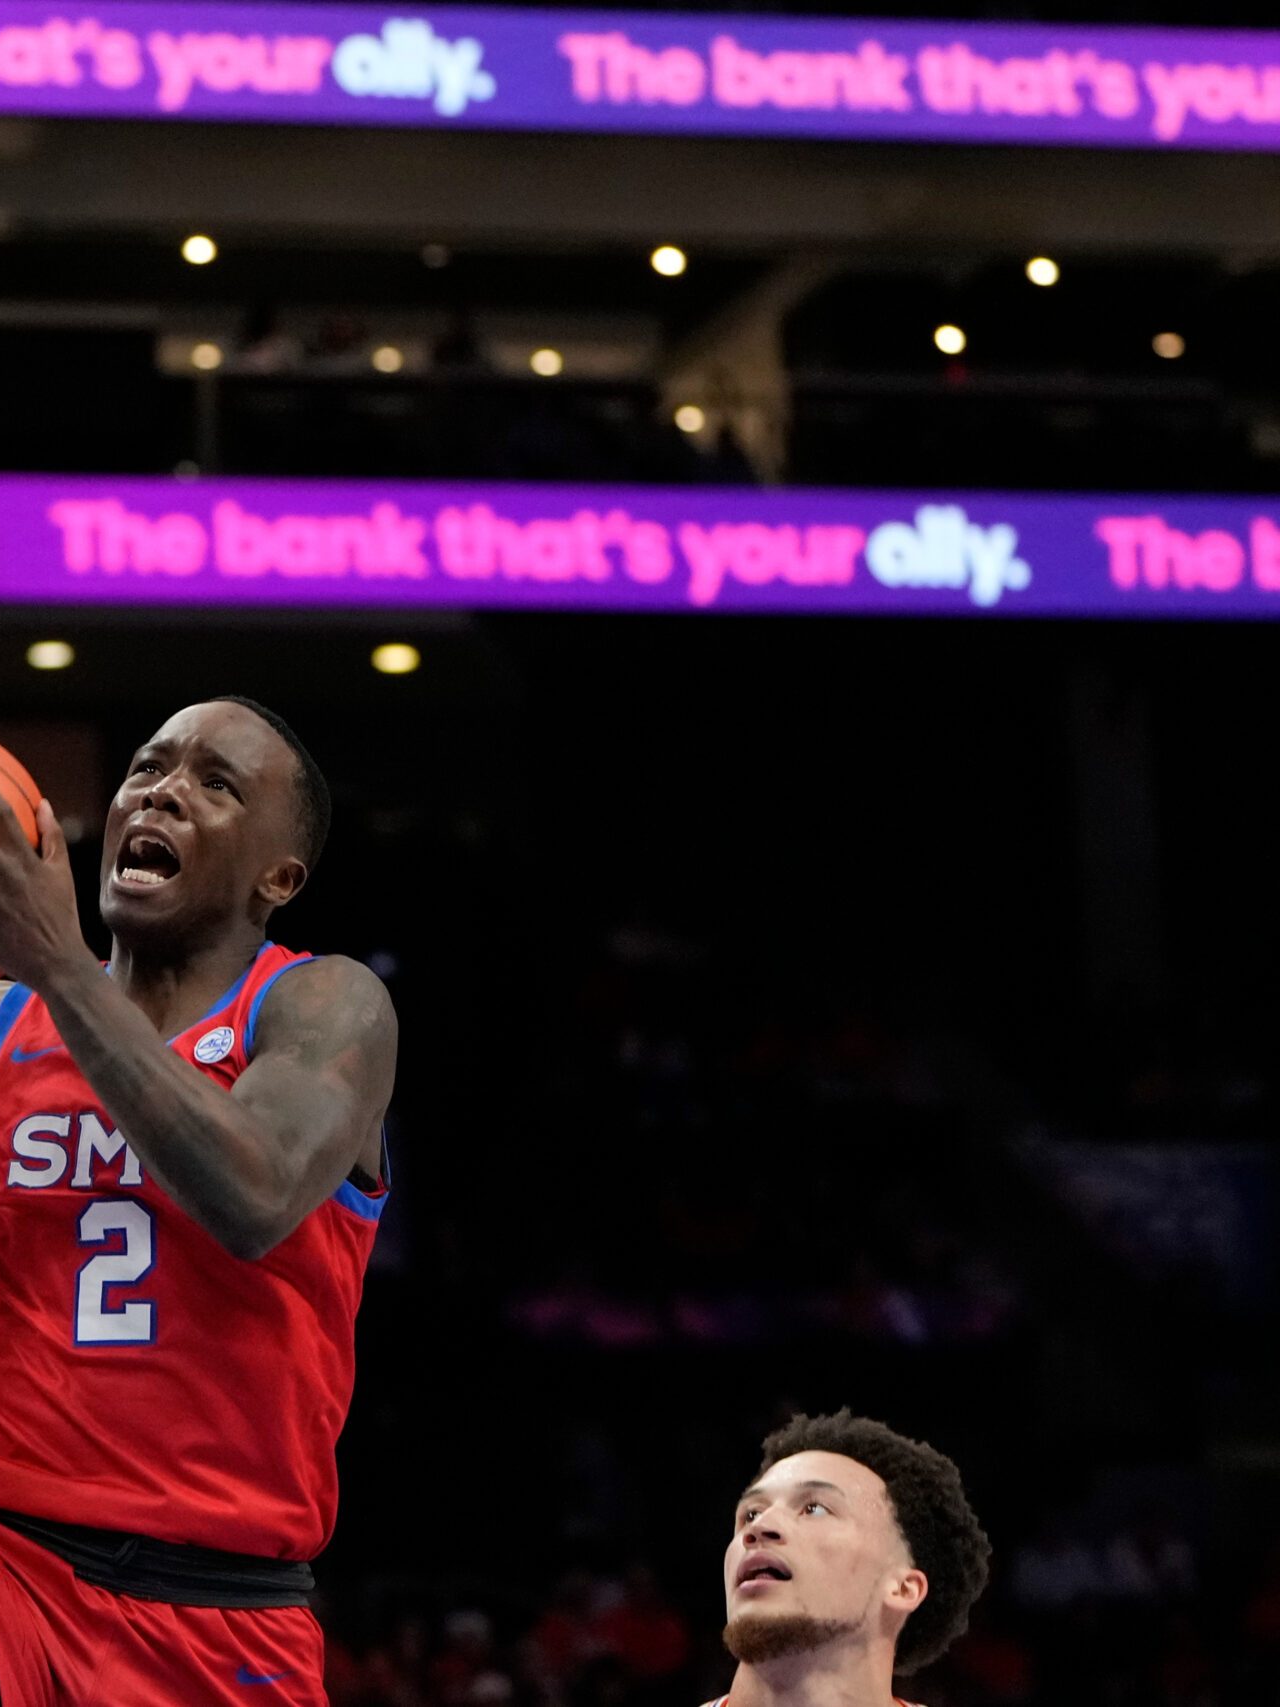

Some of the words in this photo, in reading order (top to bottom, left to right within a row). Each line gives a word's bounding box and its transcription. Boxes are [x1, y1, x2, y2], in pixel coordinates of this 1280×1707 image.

[147, 31, 330, 111] your
[558, 32, 706, 105] The
[712, 36, 911, 110] bank
[916, 44, 1140, 119] that's
[46, 498, 208, 577] The
[211, 498, 429, 579] bank
[433, 503, 673, 583] that's
[677, 522, 866, 606] your
[1096, 516, 1245, 591] The
[7, 1111, 144, 1189] SM
[74, 1198, 156, 1346] 2
